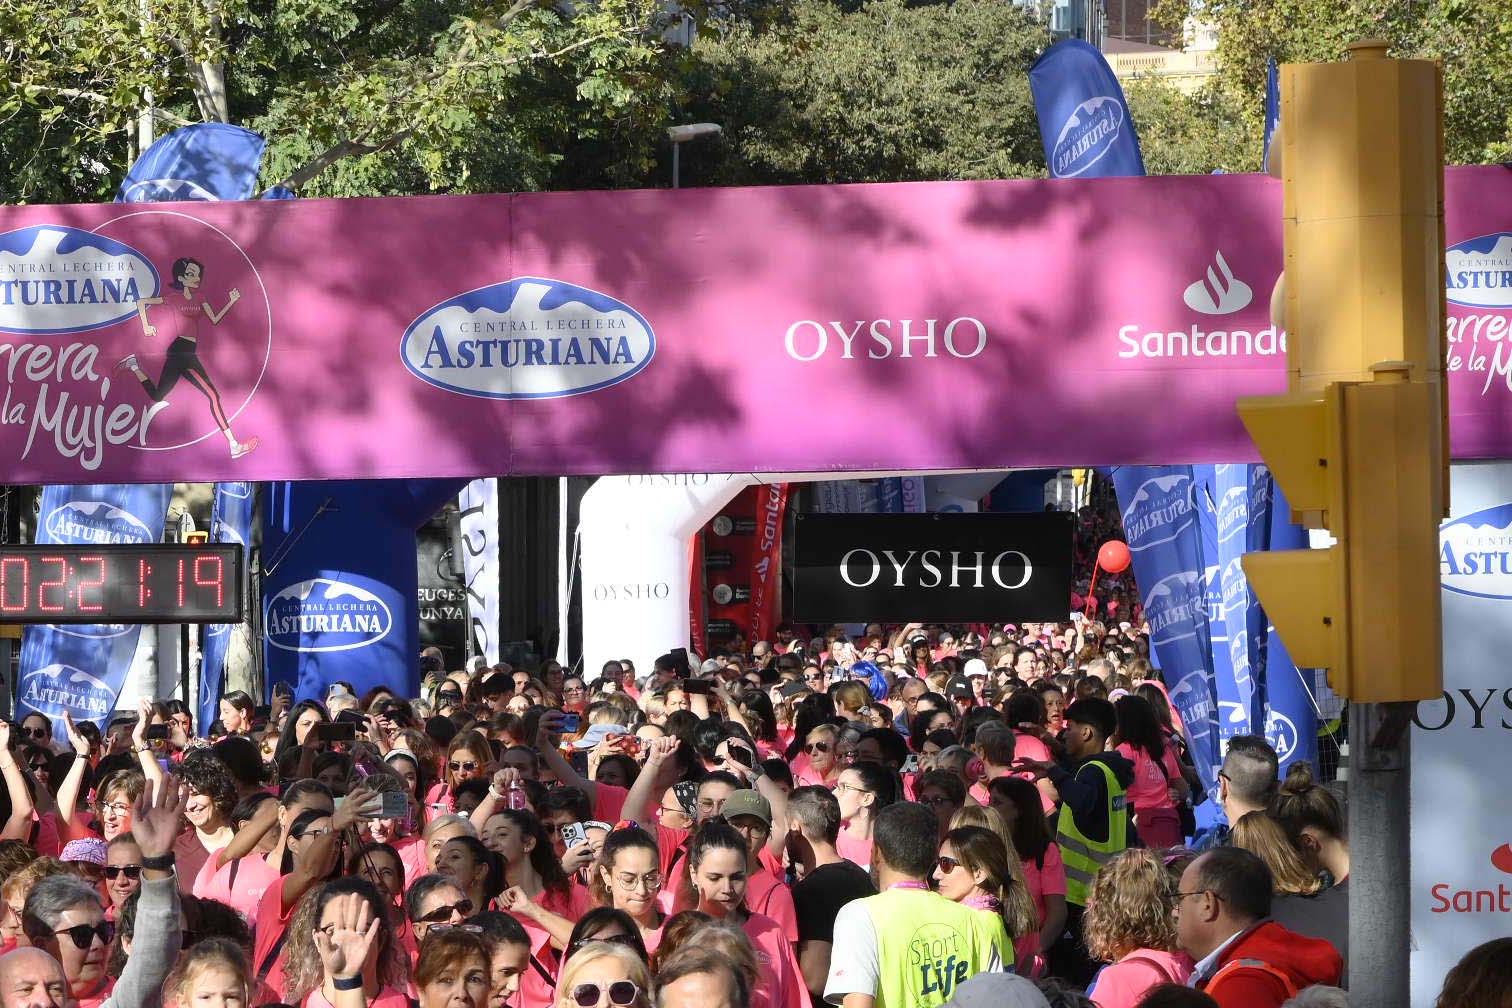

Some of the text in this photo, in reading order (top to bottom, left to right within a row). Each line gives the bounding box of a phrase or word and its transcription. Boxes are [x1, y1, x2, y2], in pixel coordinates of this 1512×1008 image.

[63, 262, 136, 273] LECHERA
[460, 318, 626, 333] CENTRAL LECHERA
[785, 316, 987, 361] OYSHO
[420, 325, 636, 369] ASTURIANA
[1468, 343, 1486, 372] la
[1, 386, 26, 425] la
[22, 377, 170, 471] Mujer
[0, 556, 223, 611] 02:21:19
[839, 548, 1034, 590] OYSHO
[594, 582, 669, 600] OYSHO
[269, 609, 383, 635] ASTURIANA
[282, 603, 377, 612] CENTRAL LECHERA
[25, 679, 108, 714] ASTURIANA
[1431, 883, 1512, 913] Sant
[921, 954, 969, 998] Life
